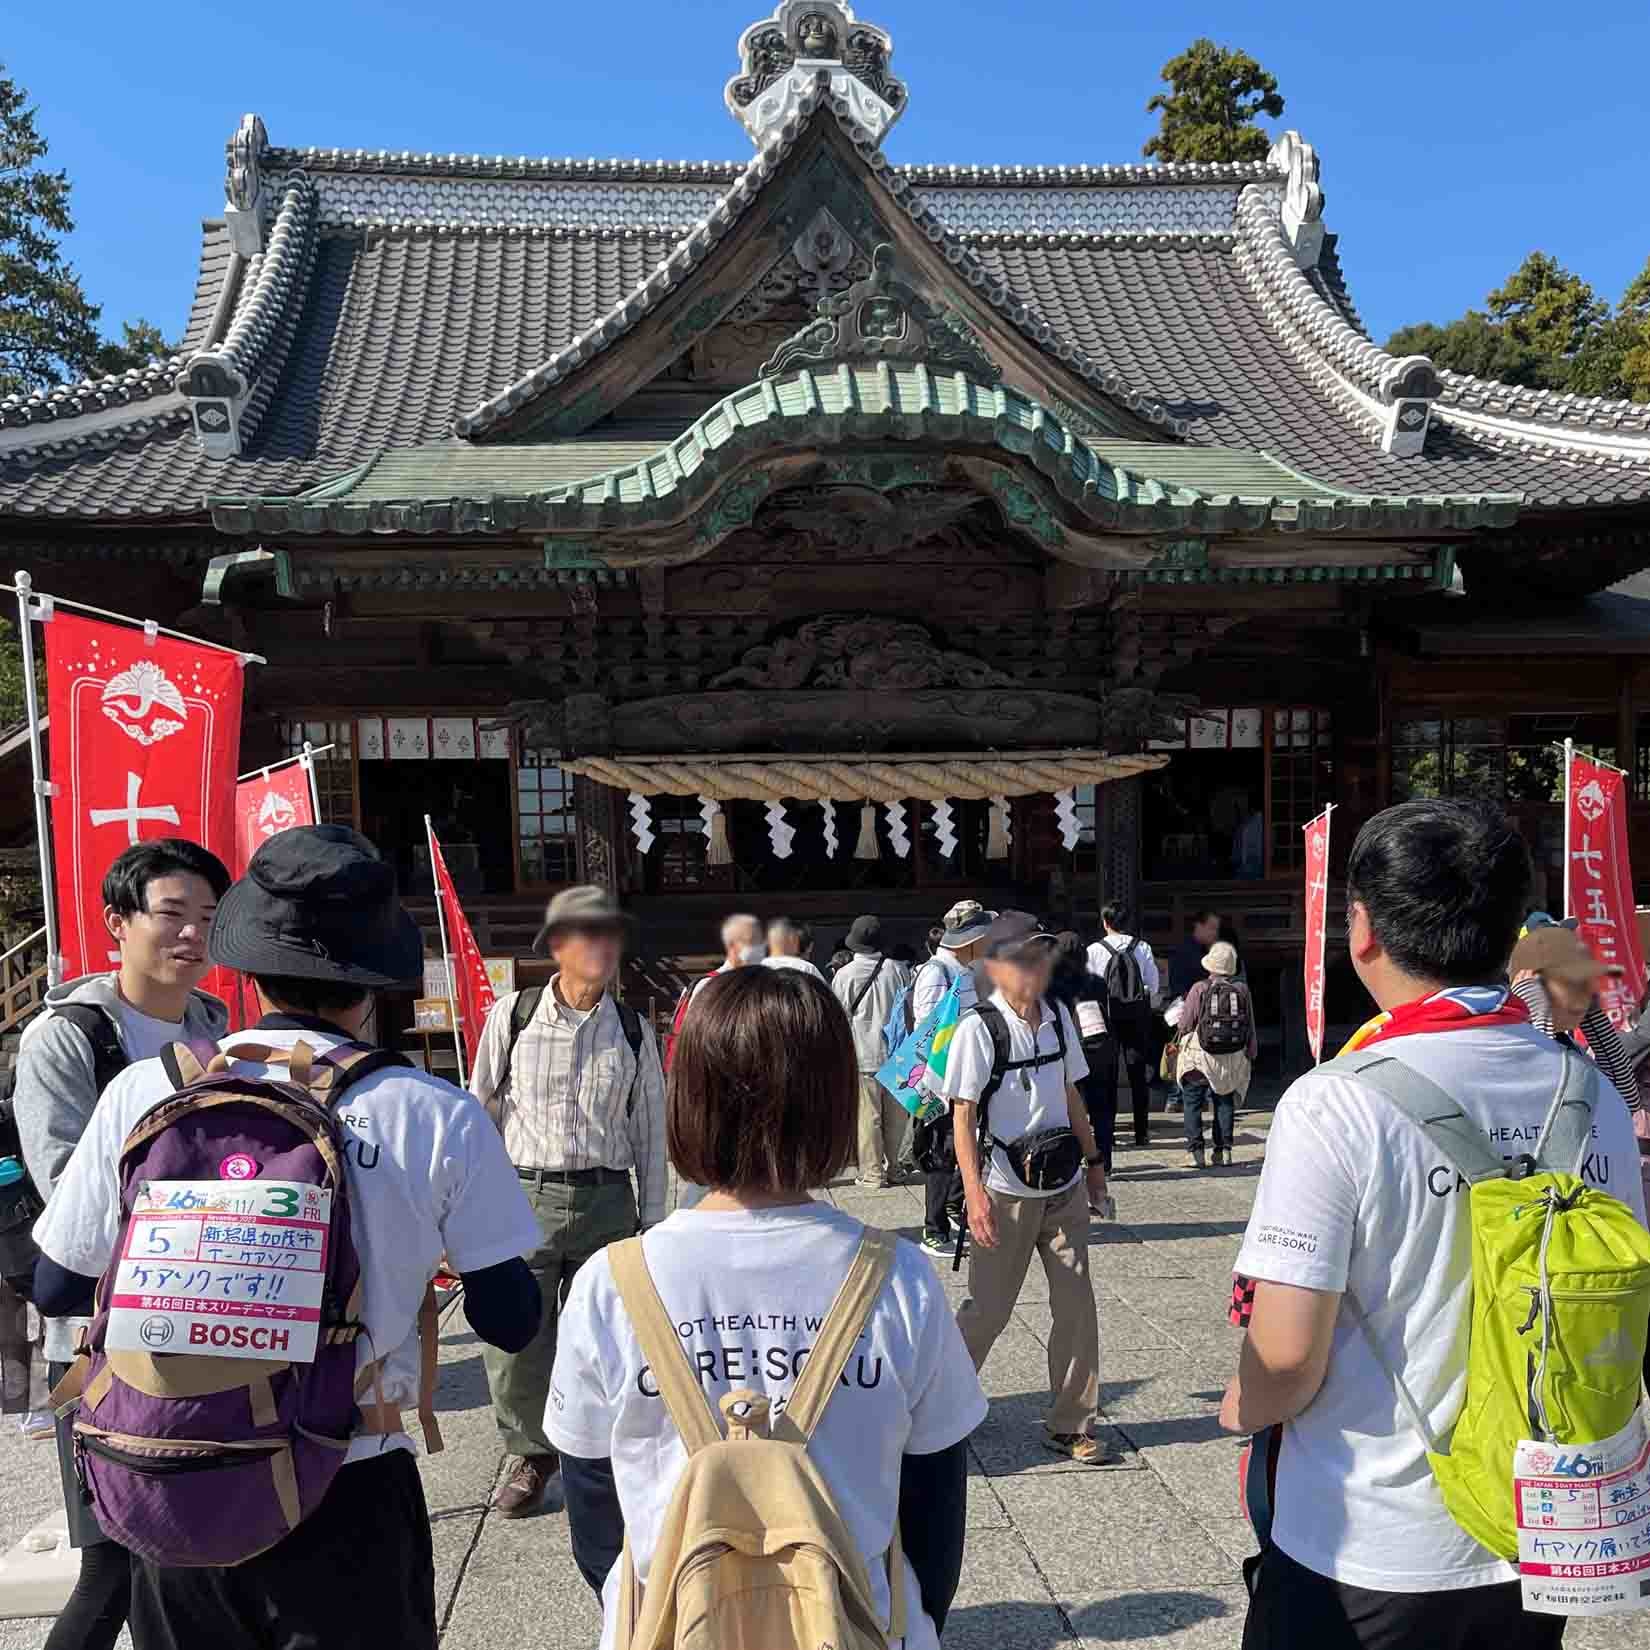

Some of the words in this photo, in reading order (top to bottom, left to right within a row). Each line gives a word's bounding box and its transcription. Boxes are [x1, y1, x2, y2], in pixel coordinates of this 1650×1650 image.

[1490, 1126, 1546, 1143] HEALT
[261, 1187, 300, 1217] 3
[303, 1207, 321, 1221] FRI
[144, 1226, 177, 1254] 5
[141, 1297, 297, 1317] 第46回日本スリーデーマーチ
[713, 1315, 796, 1332] HEALTH
[188, 1322, 290, 1351] BOSCH
